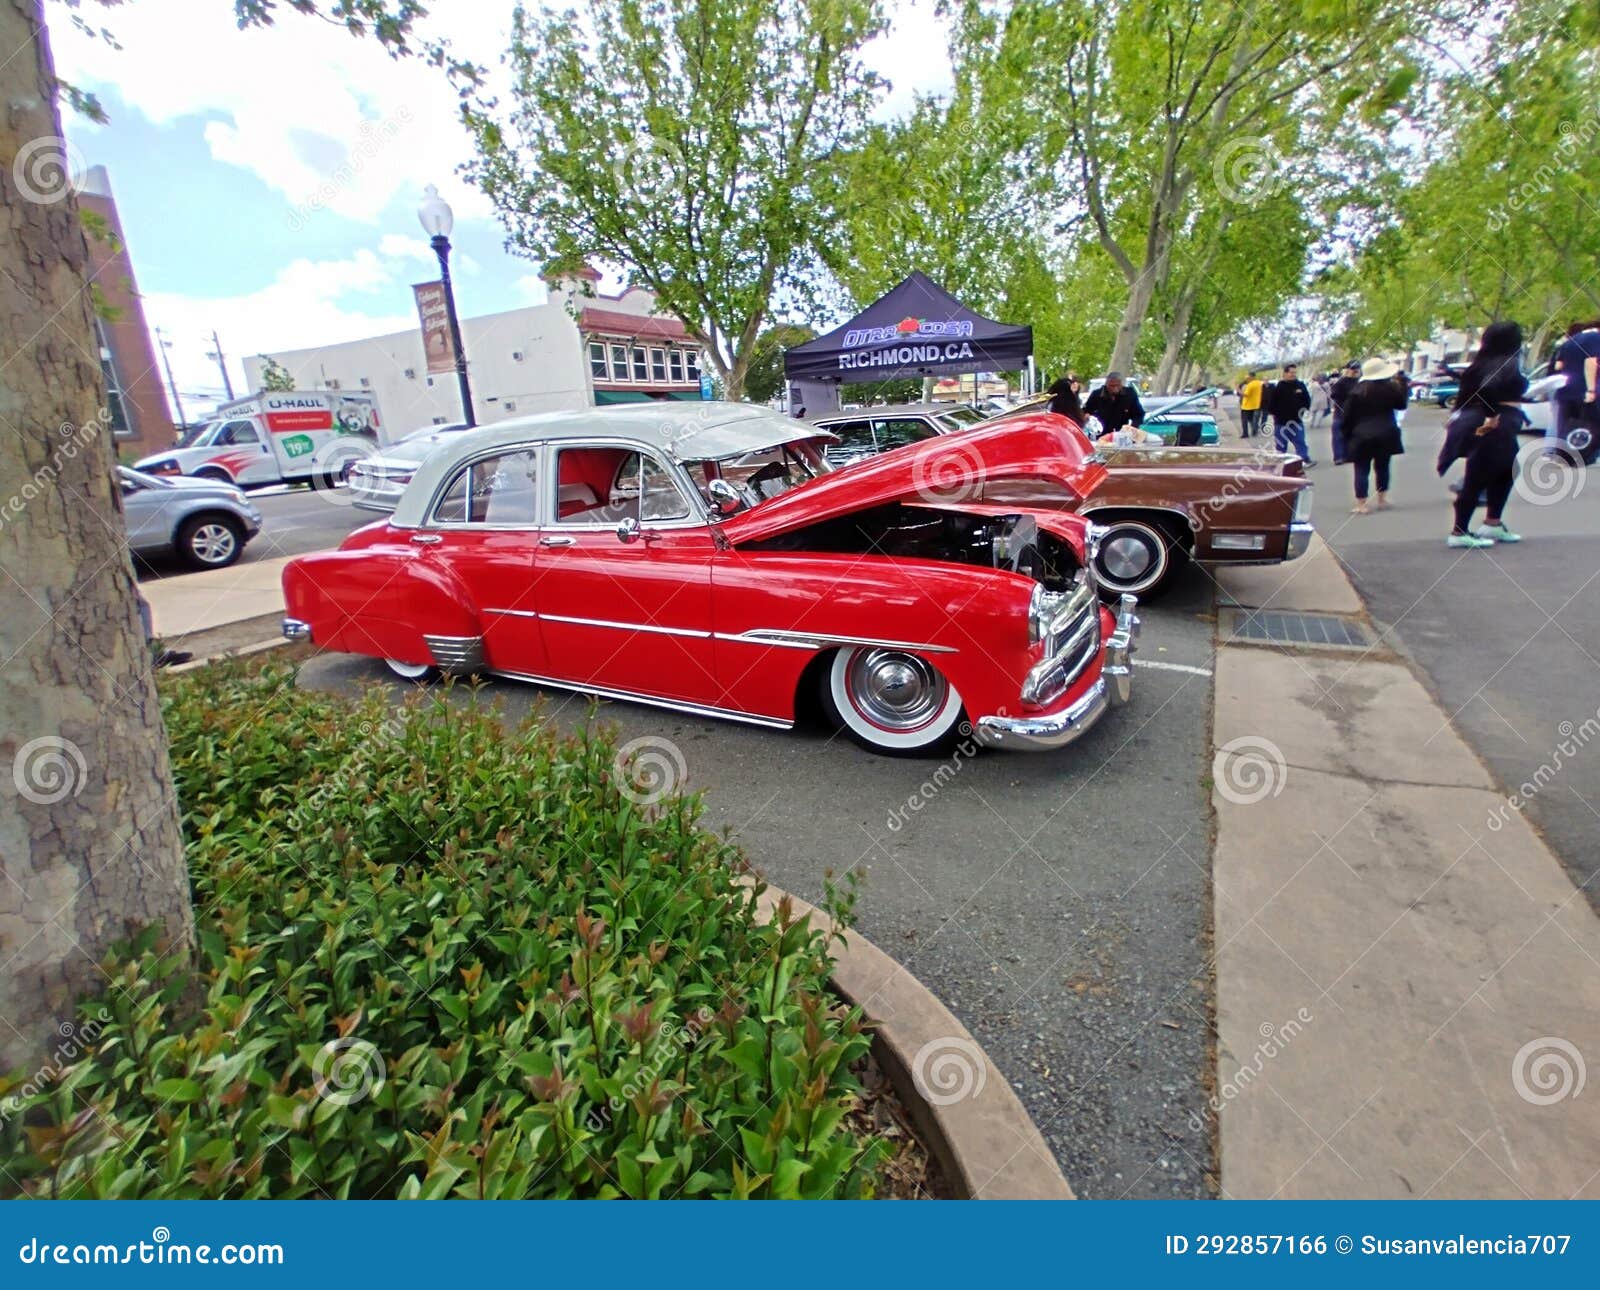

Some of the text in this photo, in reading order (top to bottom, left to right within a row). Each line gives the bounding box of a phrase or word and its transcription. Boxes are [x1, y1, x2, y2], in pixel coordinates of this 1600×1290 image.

[841, 320, 973, 348] OTRA COSA
[838, 342, 973, 369] RICHMOND,CA
[269, 398, 324, 409] U-HAUL
